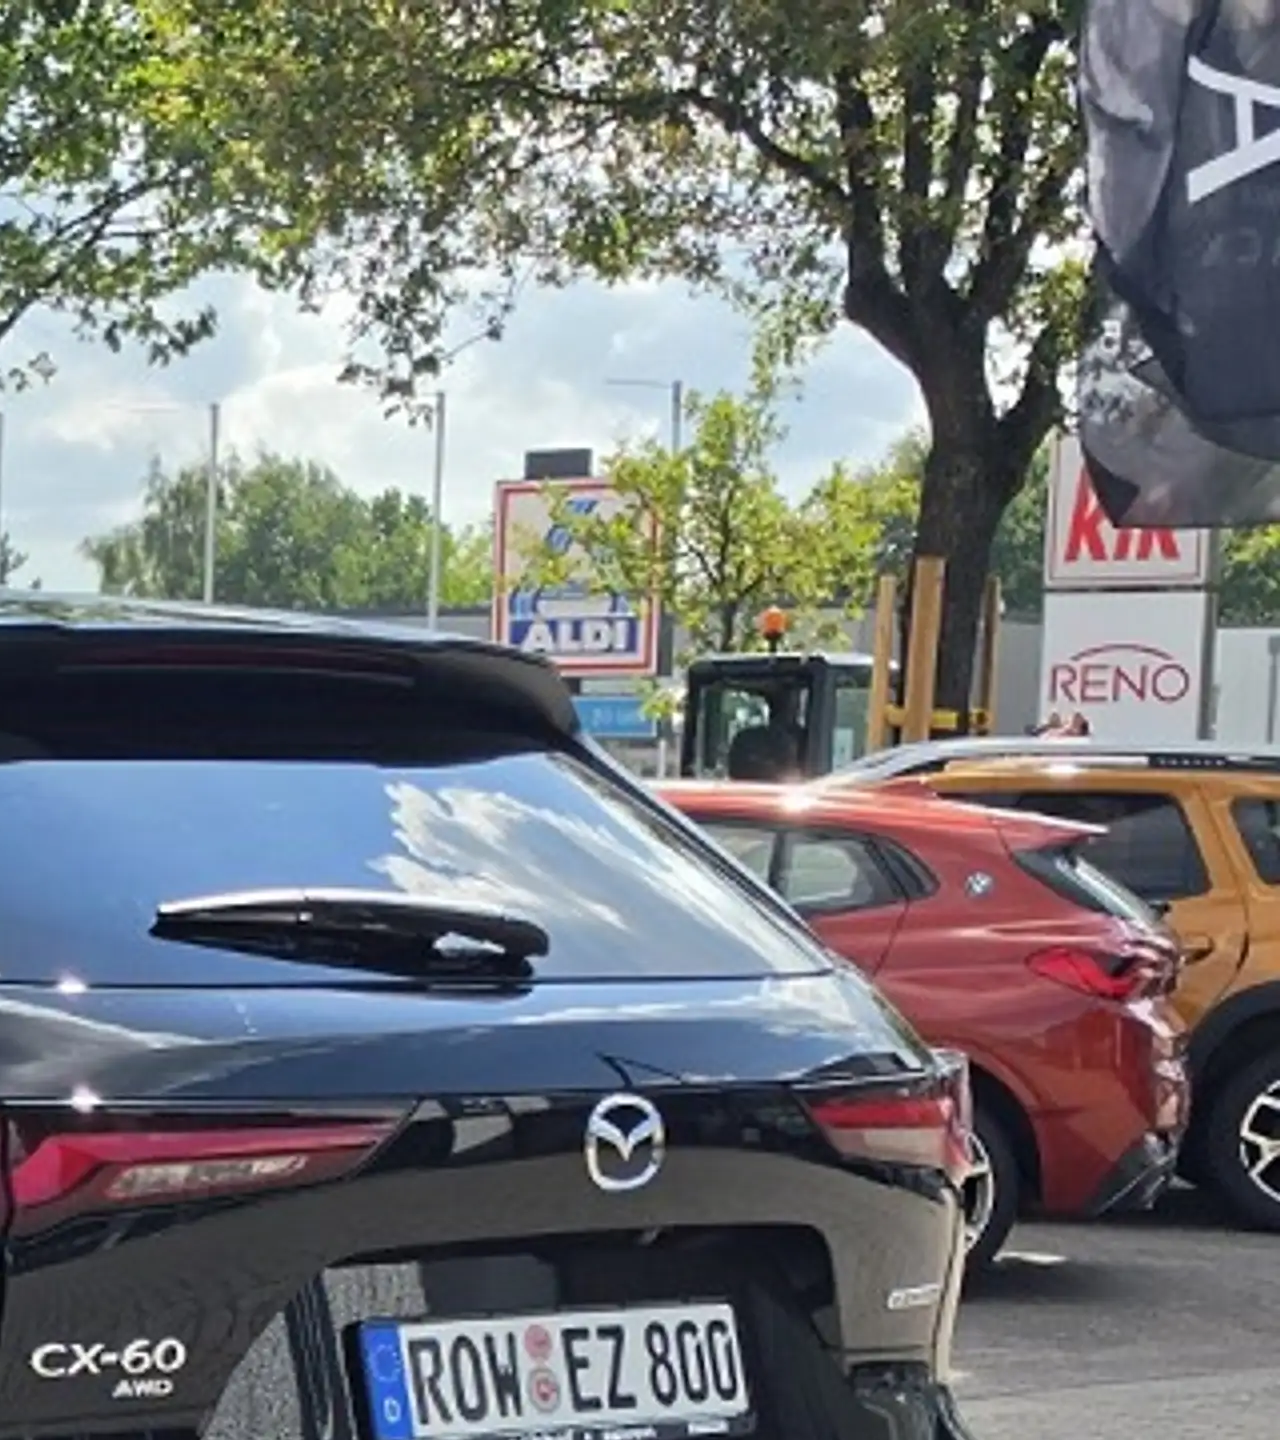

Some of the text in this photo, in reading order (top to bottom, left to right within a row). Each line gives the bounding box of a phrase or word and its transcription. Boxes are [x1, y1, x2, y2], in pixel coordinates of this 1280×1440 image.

[520, 613, 629, 652] ALDI
[1048, 663, 1190, 704] RENO
[30, 1336, 187, 1378] CX-60
[406, 1331, 524, 1425] ROW
[560, 1324, 638, 1413] EZ
[644, 1318, 738, 1407] 800
[111, 1378, 174, 1399] AWD
